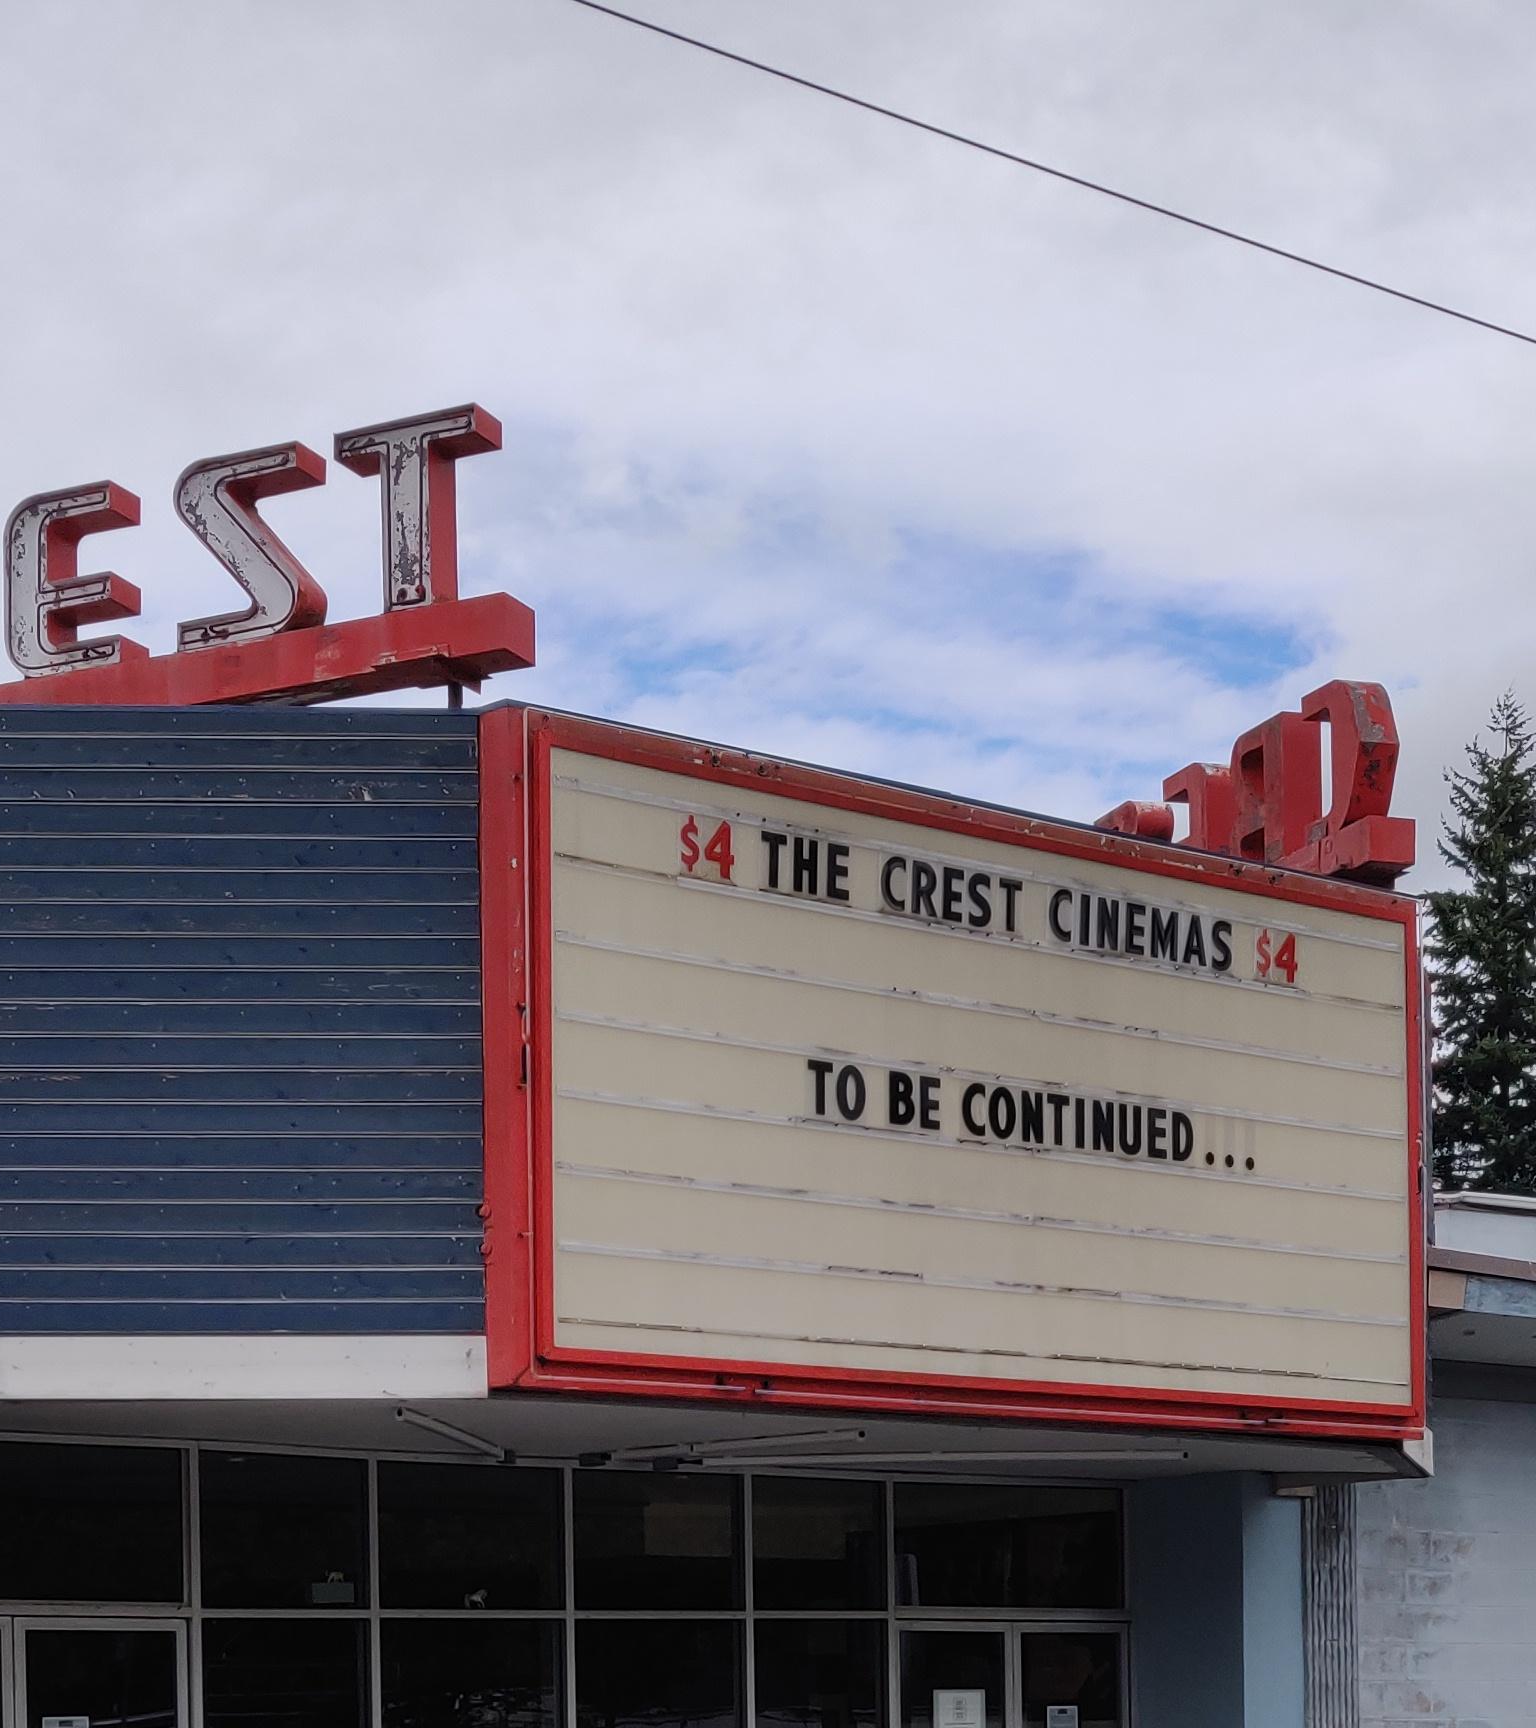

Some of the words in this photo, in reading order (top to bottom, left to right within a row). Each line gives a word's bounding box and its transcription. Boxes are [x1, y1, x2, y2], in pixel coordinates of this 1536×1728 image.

[679, 815, 735, 880] $4
[761, 830, 850, 901] THE
[880, 856, 1023, 932] CREST
[1048, 888, 1233, 971] CINEMAS
[1256, 928, 1298, 983] $4
[807, 1059, 866, 1121] TO
[888, 1070, 941, 1131] BE
[962, 1083, 1255, 1171] CONTINUED...
